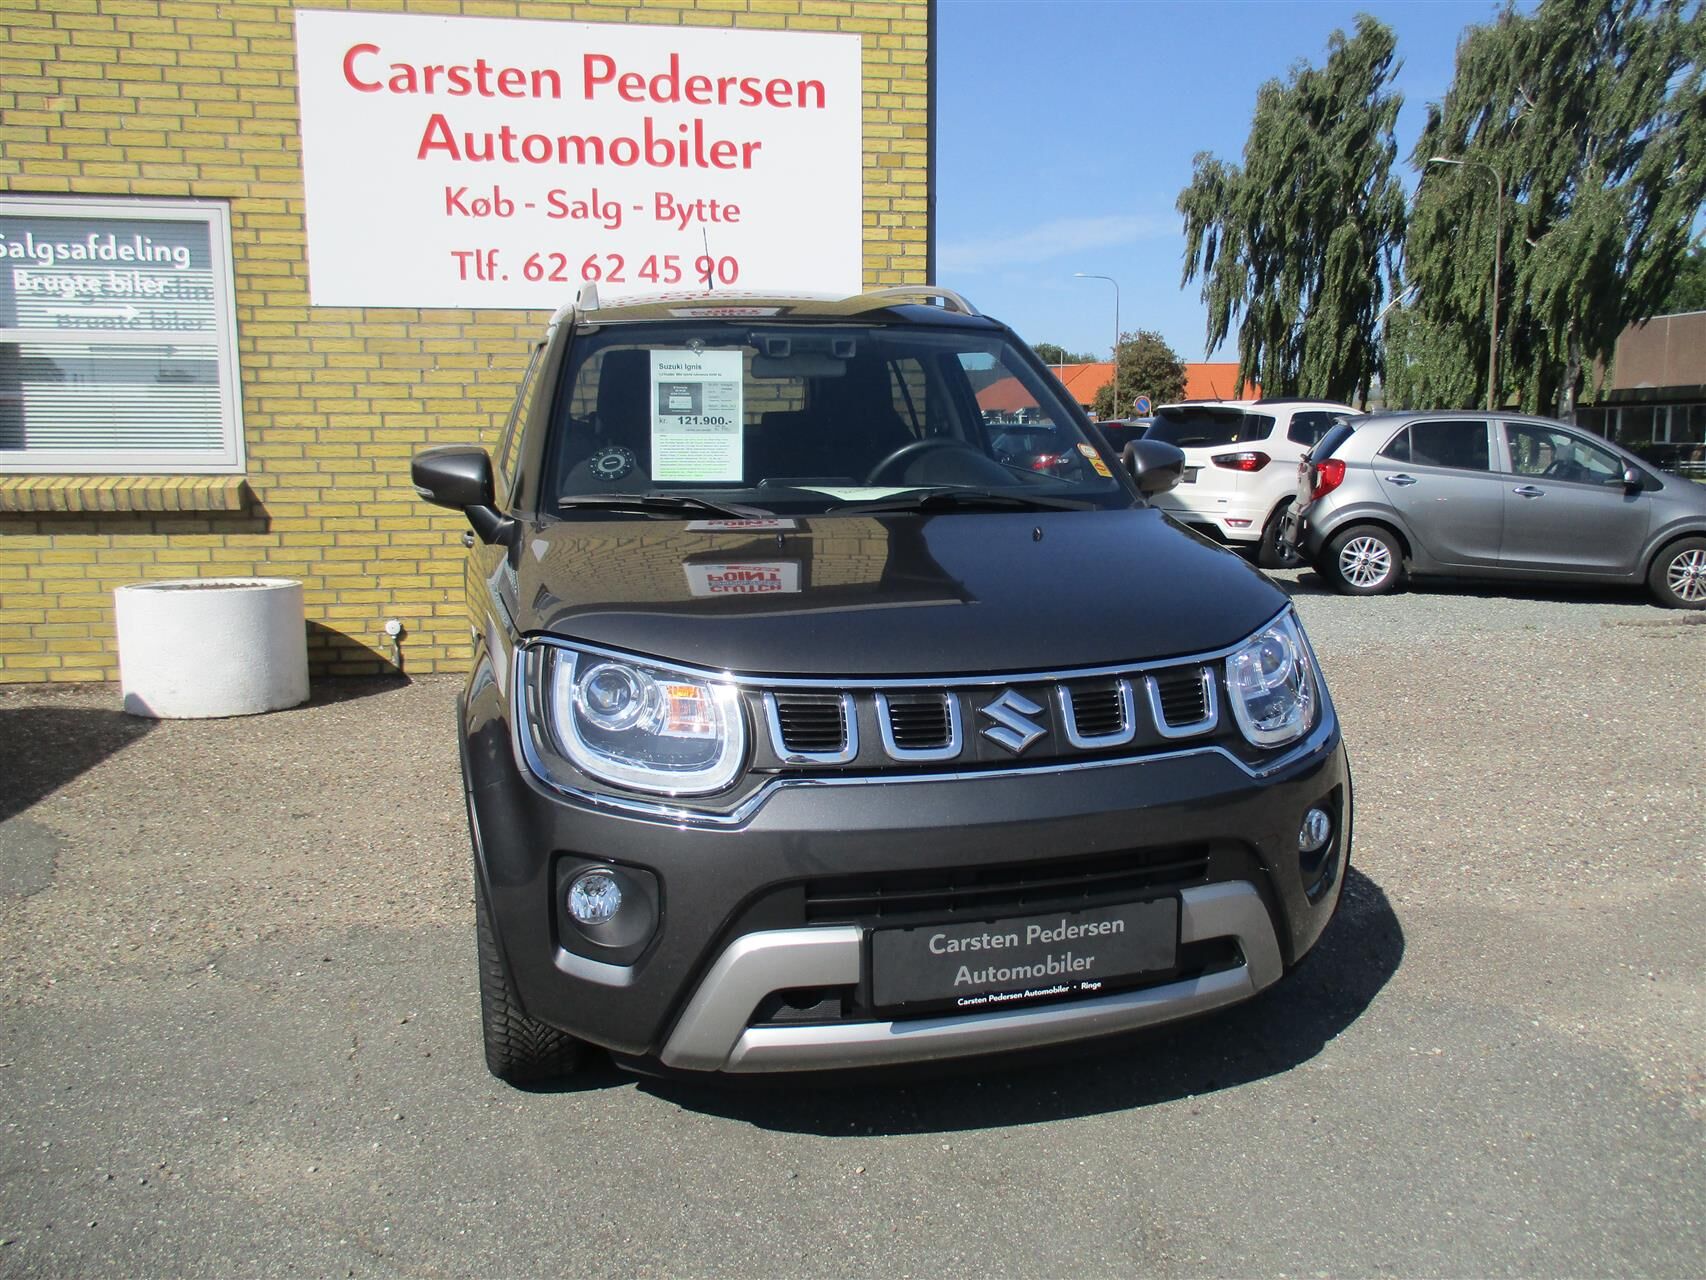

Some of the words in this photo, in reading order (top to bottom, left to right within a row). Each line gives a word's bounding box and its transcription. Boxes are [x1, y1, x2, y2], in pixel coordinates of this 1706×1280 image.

[342, 43, 561, 99] Carsten
[583, 53, 826, 109] Pedersen
[417, 113, 762, 169] Automobiler
[445, 186, 516, 218] Køb
[546, 189, 623, 230] Salg
[655, 191, 741, 230] Bytte
[13, 269, 102, 299] Brugte
[109, 270, 168, 294] biler
[451, 248, 508, 281] Tlf.
[523, 252, 568, 283] 62
[581, 253, 625, 283] 62
[639, 254, 683, 283] 45
[695, 255, 740, 285] 90
[658, 362, 683, 370] Suzuki
[684, 362, 702, 371] Ignis
[929, 930, 1018, 955] Carsten
[1027, 919, 1125, 945] Pedersen
[953, 952, 1095, 987] Automobiler
[957, 996, 987, 1006] Carsten
[988, 991, 1023, 1003] Pedersen
[1024, 984, 1070, 998] Automobiler
[1080, 980, 1102, 991] Ringe
